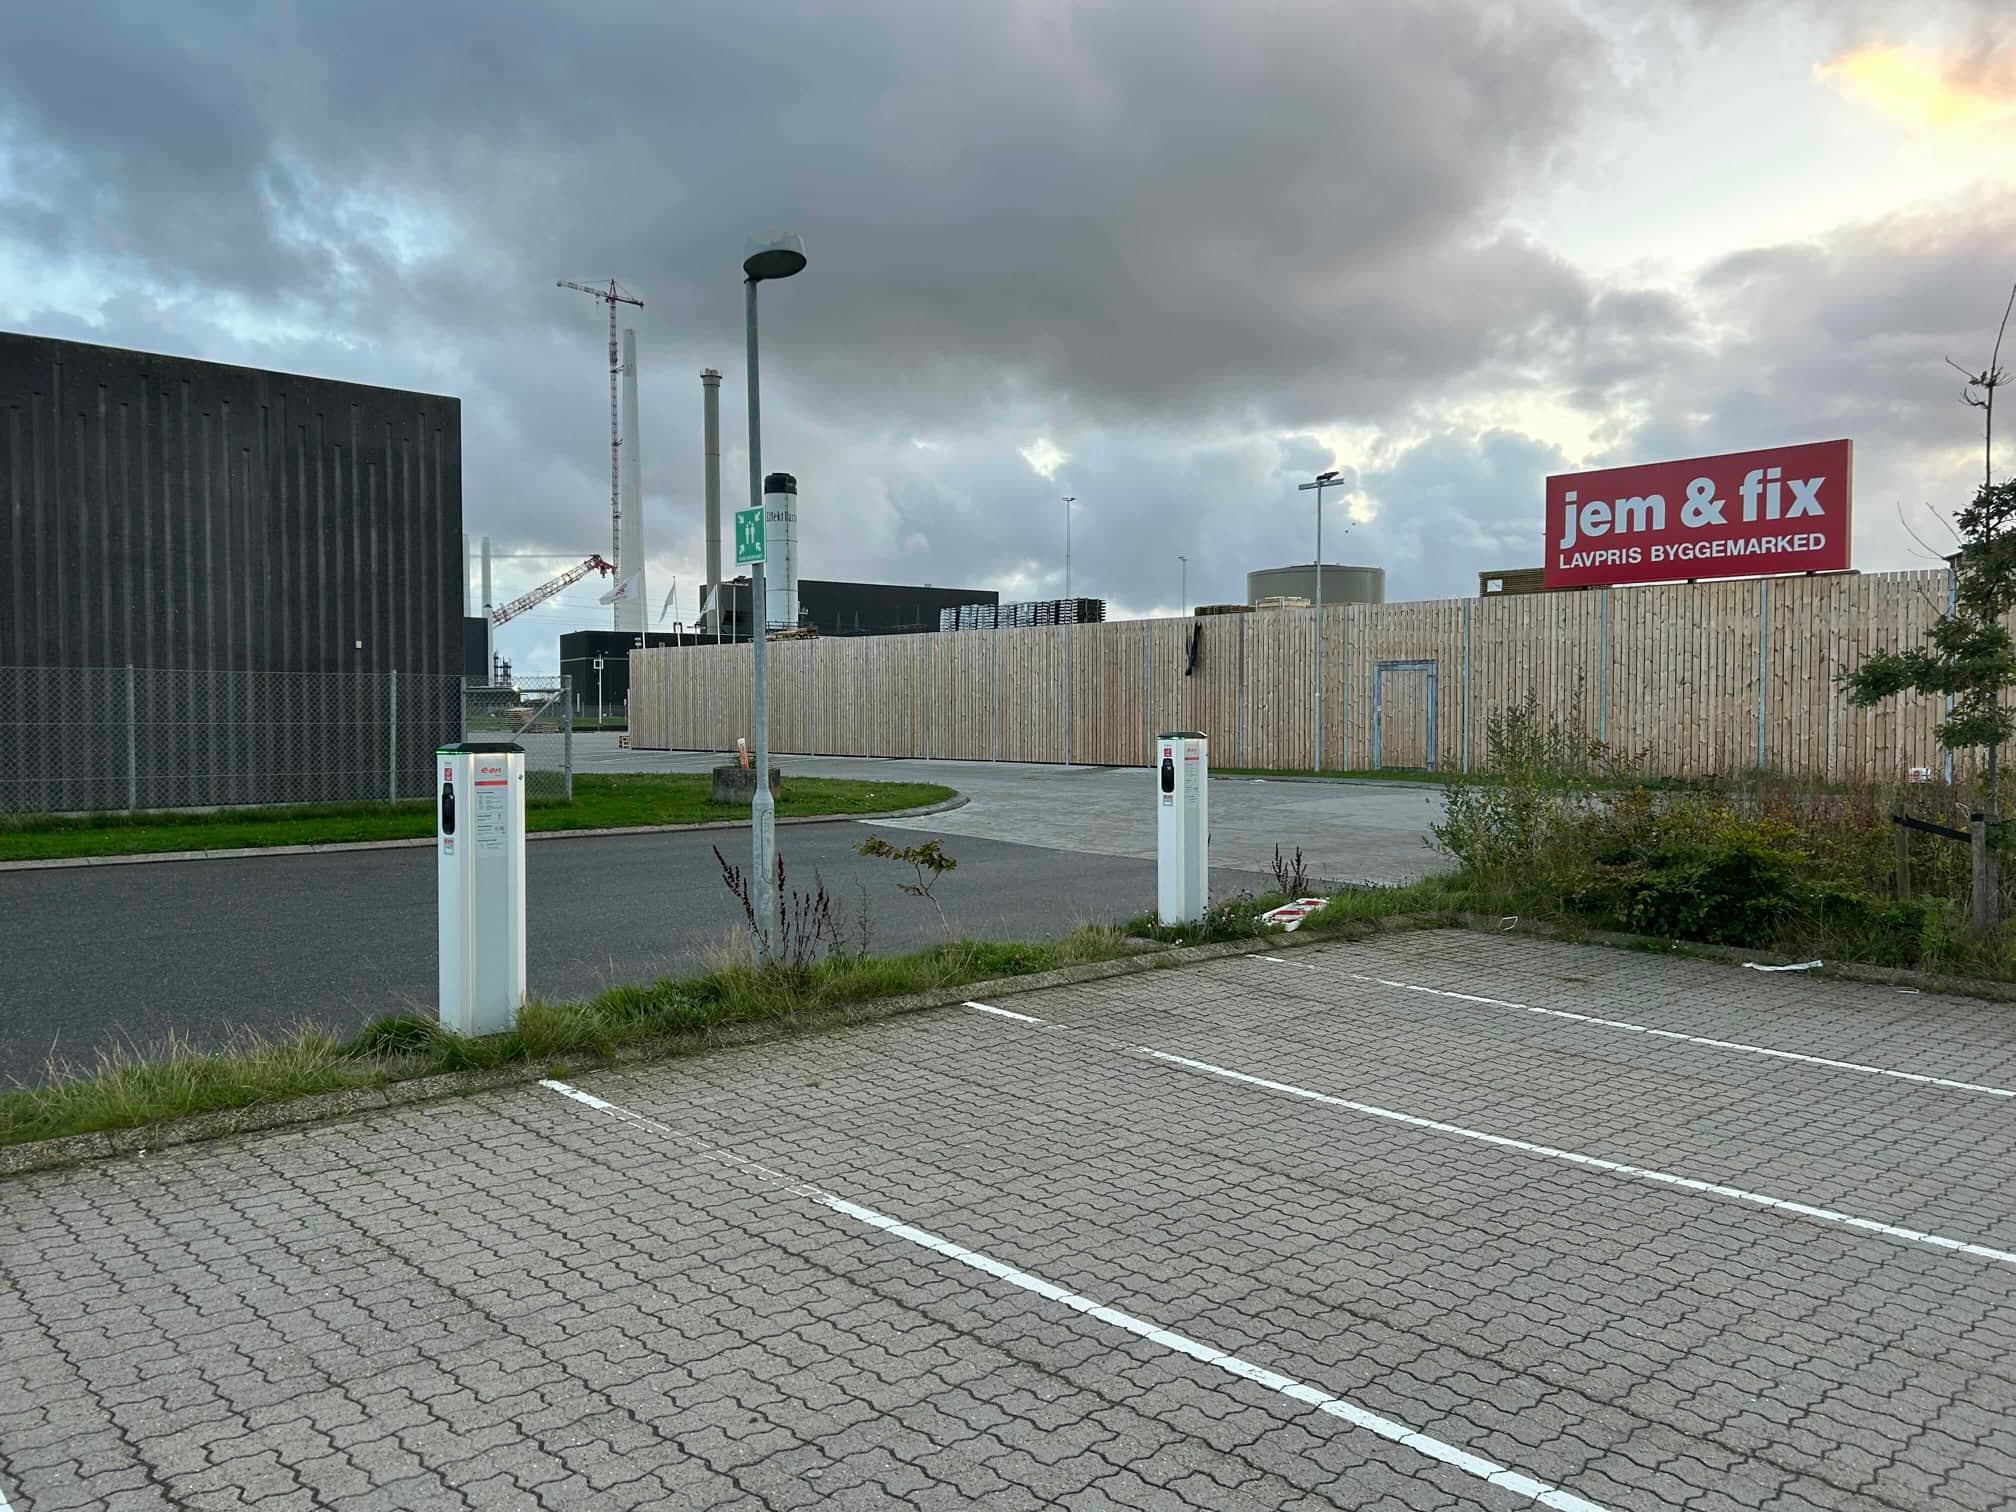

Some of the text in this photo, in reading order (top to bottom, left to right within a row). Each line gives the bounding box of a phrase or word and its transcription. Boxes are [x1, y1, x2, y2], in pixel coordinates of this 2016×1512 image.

[1560, 467, 1826, 549] jem & fix
[1559, 533, 1826, 569] LAVPRIS BYGGEMARKED
